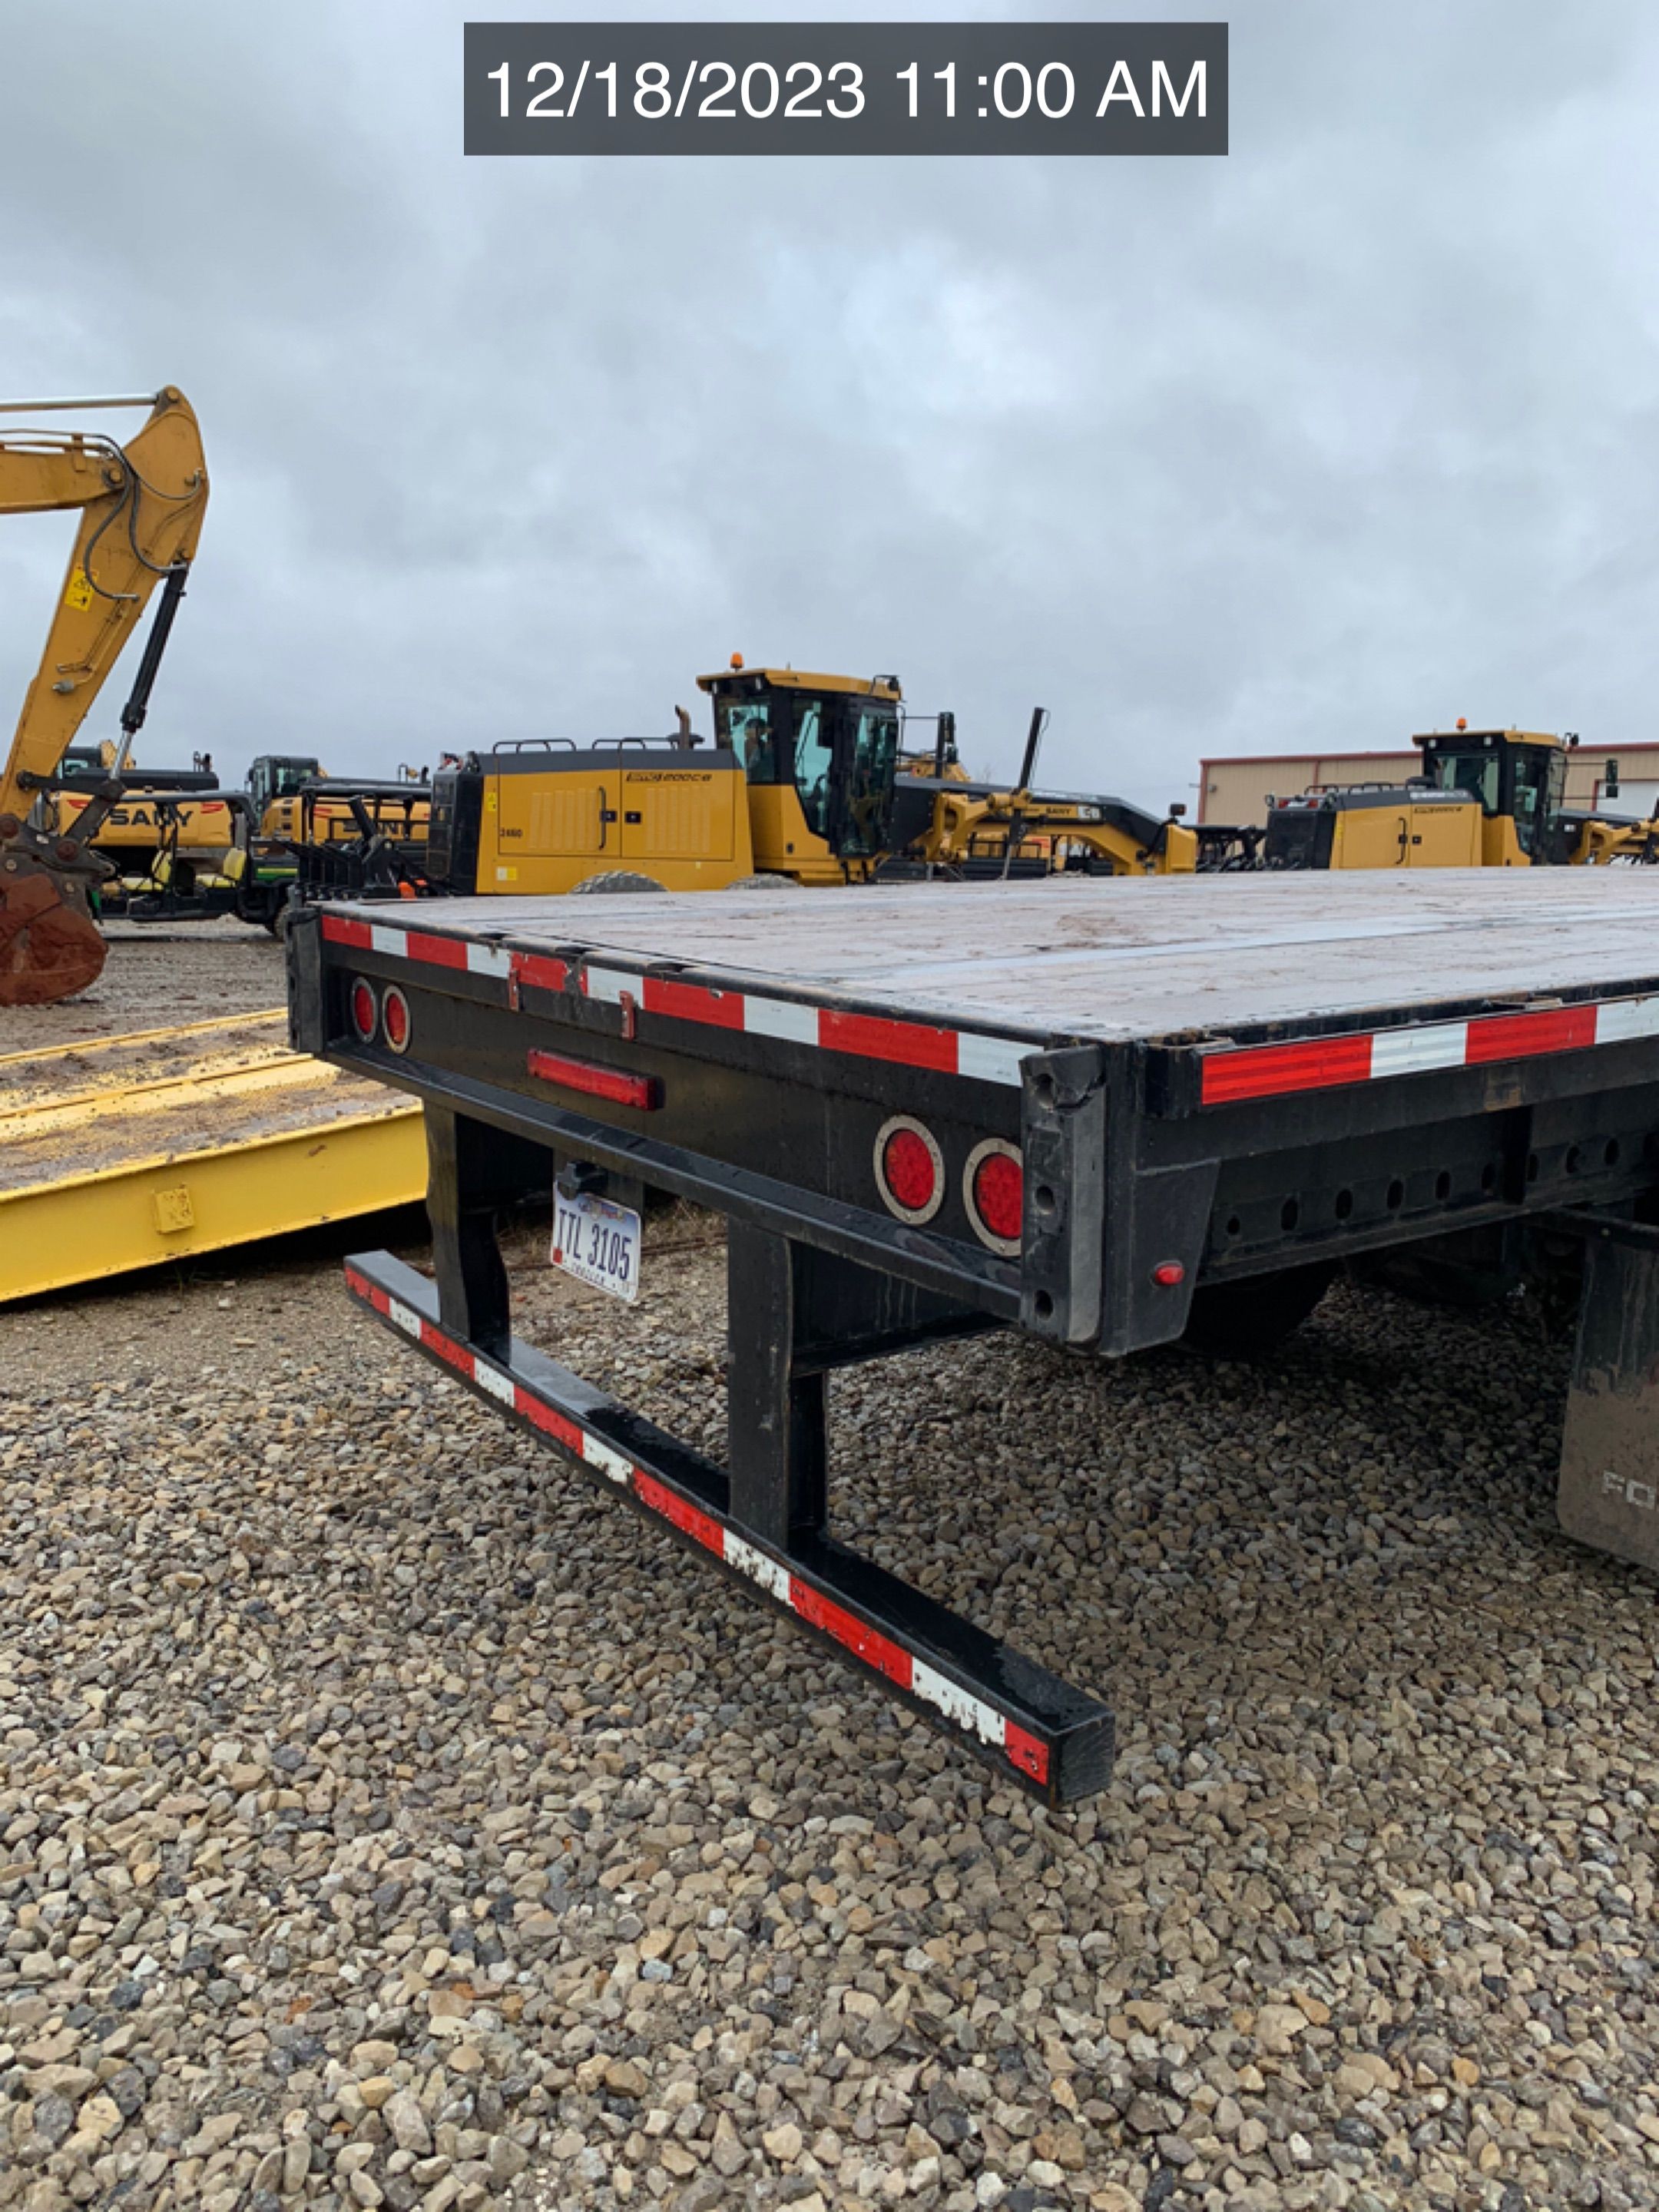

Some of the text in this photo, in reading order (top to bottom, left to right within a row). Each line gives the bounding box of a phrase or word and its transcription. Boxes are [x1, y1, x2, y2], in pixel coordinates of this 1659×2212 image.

[109, 808, 194, 826] SANY
[558, 1208, 581, 1259] TTL
[588, 1224, 631, 1280] 3105
